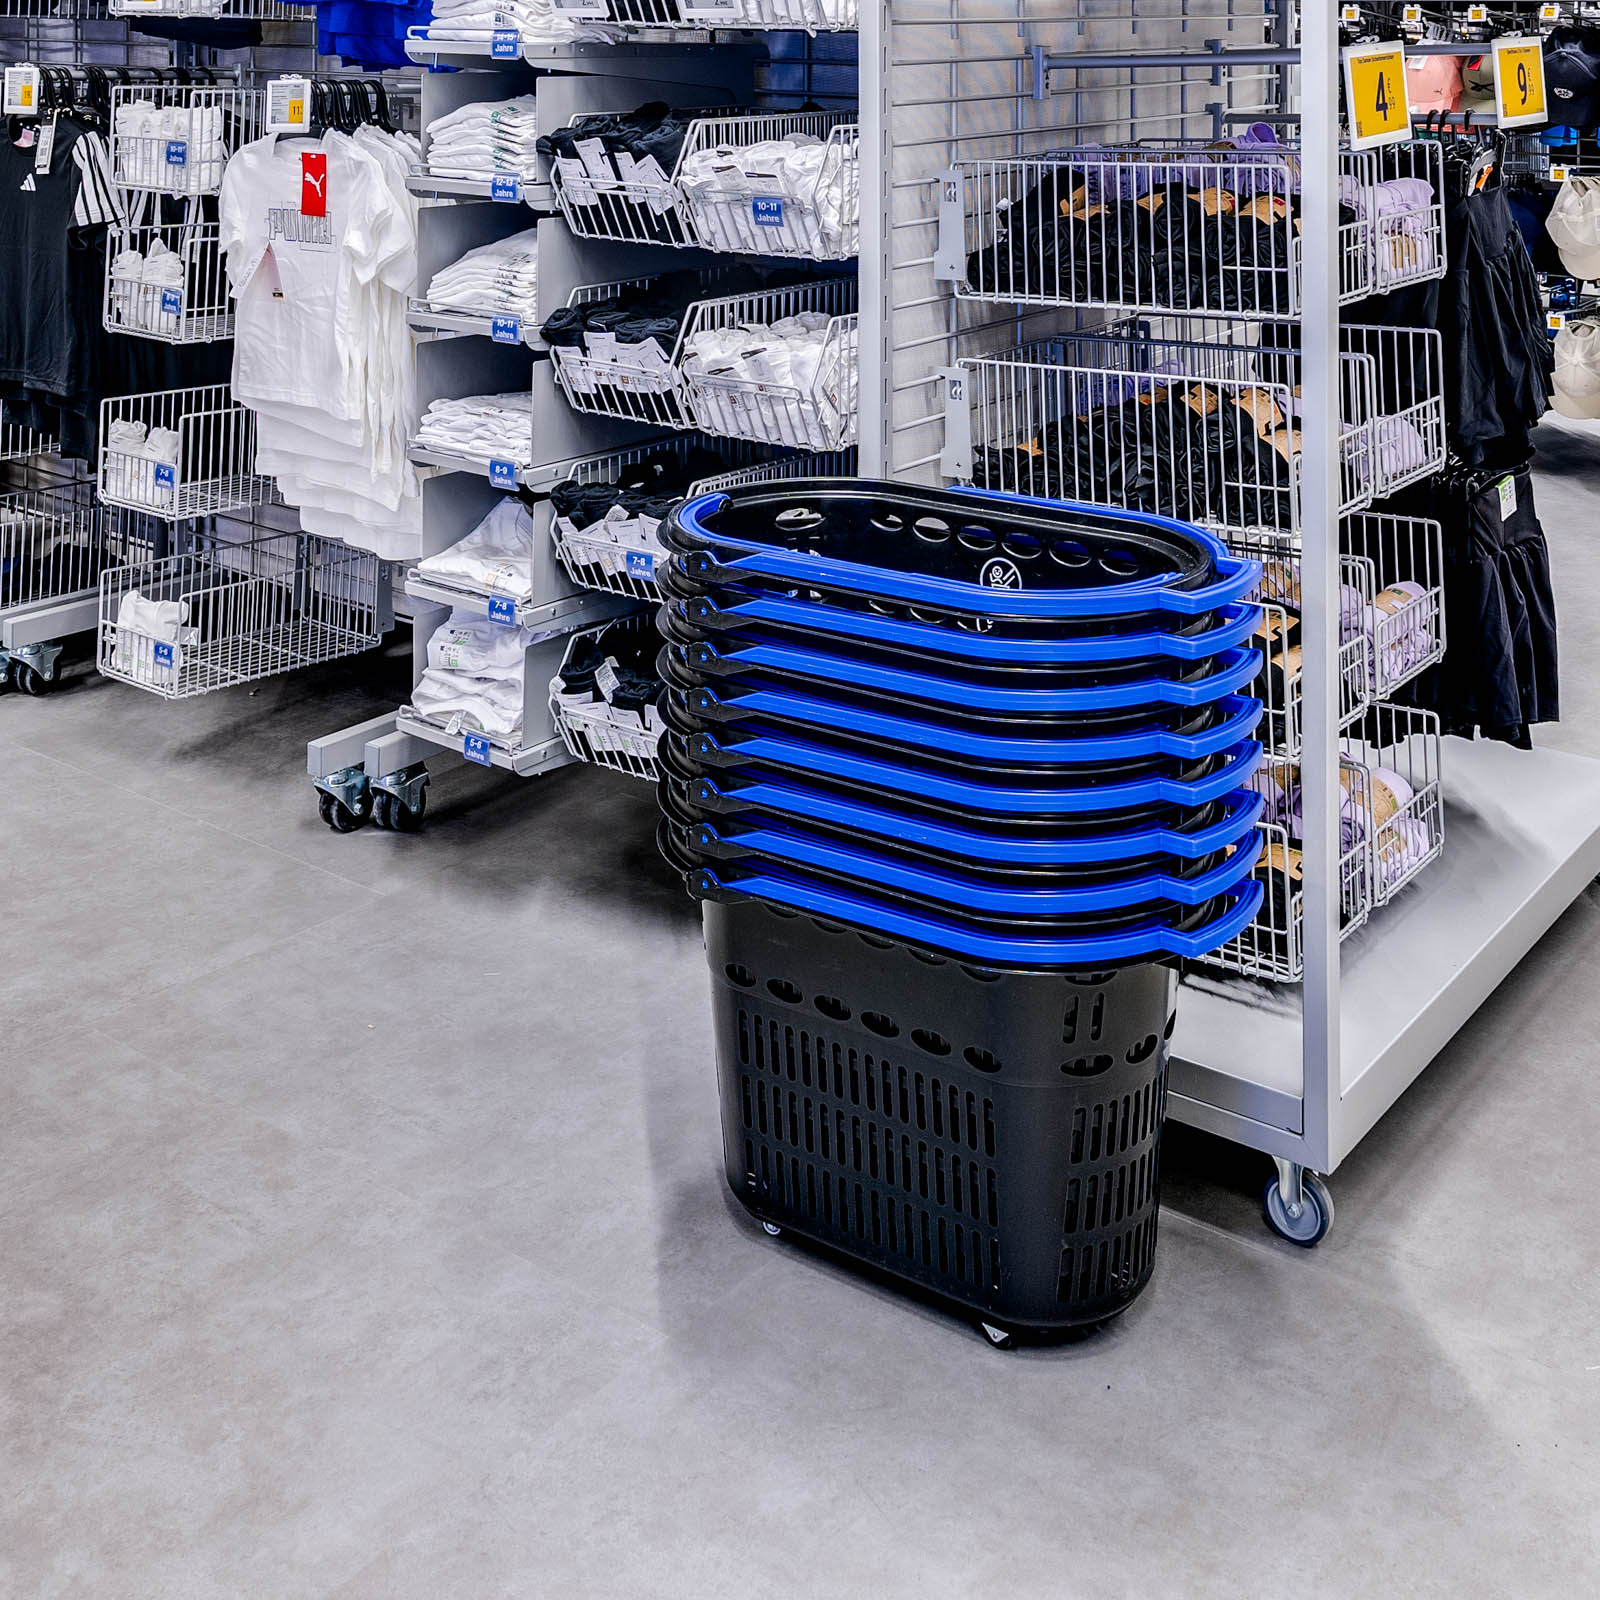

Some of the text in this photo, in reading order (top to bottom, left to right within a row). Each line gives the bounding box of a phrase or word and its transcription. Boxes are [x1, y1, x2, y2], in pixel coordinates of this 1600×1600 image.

[495, 43, 513, 53] Jahre
[1517, 62, 1527, 105] 9
[1375, 71, 1388, 121] 4
[495, 188, 513, 198] Jahre
[757, 202, 777, 211] 10-11
[758, 213, 780, 223] Jahre
[497, 318, 514, 328] 10-11
[496, 329, 514, 340] Jahre
[159, 468, 169, 477] 7-8
[495, 465, 508, 475] 8-9
[493, 475, 512, 486] Jahre
[632, 556, 646, 566] 7-8
[630, 567, 651, 578] Jahre
[494, 600, 507, 610] 7-8
[491, 611, 511, 622] Jahre
[159, 647, 168, 655] 5-6
[469, 738, 482, 749] 5-6
[466, 749, 485, 761] Jahre
